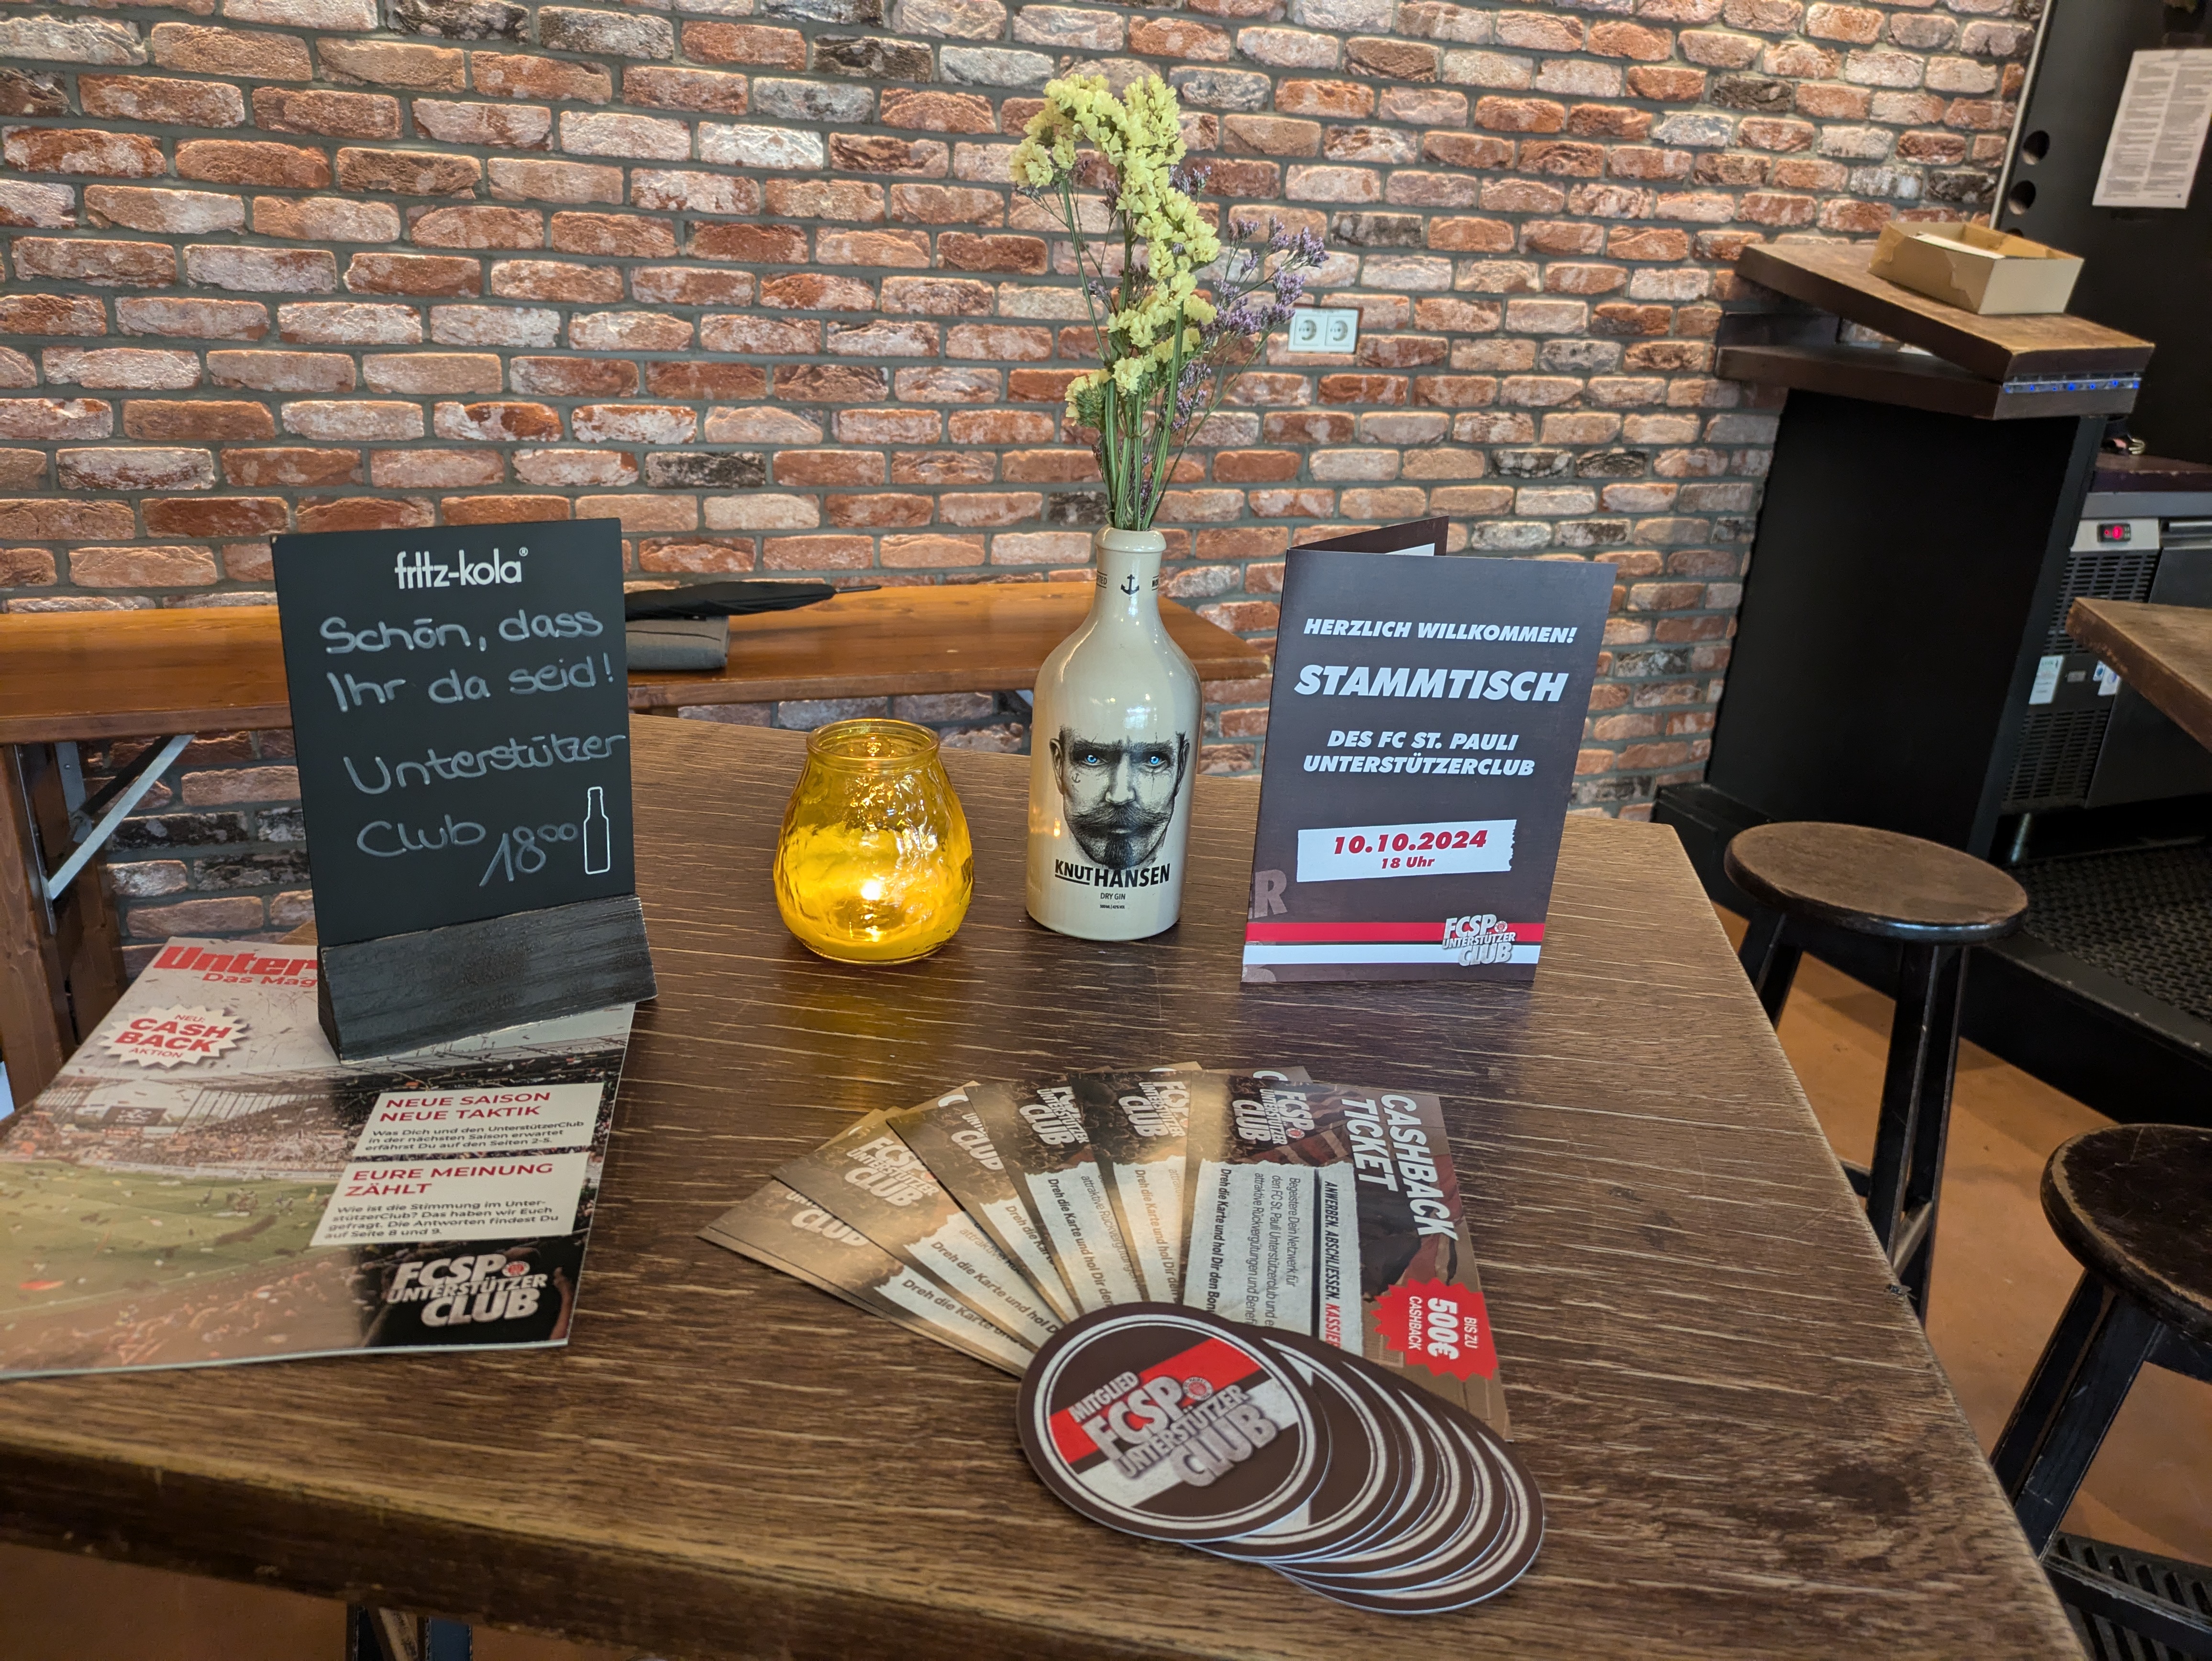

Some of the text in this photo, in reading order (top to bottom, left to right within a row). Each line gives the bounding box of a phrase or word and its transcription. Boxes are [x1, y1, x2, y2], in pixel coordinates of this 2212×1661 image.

[499, 609, 604, 642] dass
[1303, 618, 1577, 643] HERZLICH WILLKOMMEN!
[327, 653, 614, 712] Ihr da seid!
[1294, 664, 1570, 702] STAMMTISCH
[1327, 731, 1518, 751] DES FC ST. PAULI
[343, 734, 626, 795] Unterstützer
[1303, 752, 1536, 776] UNTERSTÜTZERCLUB
[357, 814, 486, 858] Club
[1334, 829, 1488, 855] 10.10.2024
[1382, 855, 1435, 870] 18 Uhr
[1443, 914, 1497, 939] FCSP
[1442, 932, 1516, 949] UNTERSTÜTZER
[1459, 942, 1512, 966] CLUB
[202, 973, 253, 984] Das
[130, 1018, 232, 1039] CASH
[115, 1031, 220, 1052] BACK
[130, 1047, 184, 1059] AKTION
[386, 1092, 551, 1108] NEUE SAISON
[1139, 1082, 1186, 1138] UNTERSTÜTZER
[1270, 1090, 1315, 1131] FCSP
[380, 1106, 542, 1122] NEUE TAKTIK
[488, 1120, 584, 1132] UnterstützerClub
[1019, 1104, 1075, 1145] CLUB
[1037, 1088, 1090, 1144] UNTERSTÜTZER
[1118, 1096, 1169, 1137] CLUB
[1232, 1099, 1272, 1141] CLUB
[1260, 1088, 1288, 1145] UNTERSTÜTZER
[365, 1142, 415, 1152] erfährst
[489, 1138, 529, 1146] Seiten
[407, 1133, 466, 1143] nächsten
[468, 1131, 509, 1141] Saison
[511, 1129, 564, 1139] erwartet
[1341, 1098, 1399, 1192] TICKET
[353, 1168, 423, 1181] EURE
[431, 1163, 553, 1177] MEINUNG
[846, 1148, 940, 1196] UNTERSTÜTZER
[1135, 1169, 1149, 1189] Dreh
[1381, 1094, 1459, 1241] CASHBACK
[344, 1182, 432, 1196] ZÄHLT
[844, 1167, 923, 1207] CLUB
[1048, 1178, 1065, 1198] Dreh
[1081, 1175, 1104, 1210] attraktive
[1253, 1172, 1264, 1206] attraktive
[1272, 1175, 1281, 1189] den
[410, 1201, 482, 1211] Stimmung
[1057, 1197, 1070, 1212] die
[1141, 1189, 1152, 1202] die
[1271, 1201, 1283, 1213] St.
[1272, 1190, 1283, 1201] FC
[1325, 1181, 1338, 1228] ANWERBEN.
[328, 1221, 384, 1232] gefragt.
[412, 1218, 487, 1227] Antworten
[489, 1216, 536, 1225] findest
[333, 1211, 418, 1222] stützerClub?
[450, 1208, 492, 1217] haben
[520, 1206, 553, 1215] Euch
[1005, 1206, 1037, 1240] Dreh die
[1064, 1211, 1082, 1238] Karte
[1146, 1203, 1160, 1226] Karte
[1269, 1212, 1282, 1231] Pauli
[324, 1230, 347, 1240] auf
[1153, 1226, 1165, 1245] und
[1206, 1168, 1232, 1313] Dreh die Karte und hol Dir den Bon
[1245, 1206, 1264, 1274] Rückvergütungen
[1286, 1177, 1301, 1287] Begeistere Dein Netzwerk für
[1076, 1236, 1094, 1256] und
[1158, 1245, 1172, 1260] hol
[391, 1253, 508, 1290] FCSP
[1084, 1254, 1096, 1270] hol
[1162, 1262, 1176, 1275] Dir
[1266, 1231, 1281, 1300] Unterstützerclub
[1325, 1229, 1340, 1300] ABSCHLIESSEN.
[387, 1273, 549, 1305] UNTERSTÜTZER
[931, 1241, 1050, 1327] Dreh die Karte und hol
[1091, 1267, 1106, 1287] Dir
[1246, 1275, 1258, 1292] und
[902, 1279, 955, 1310] Dreh die
[420, 1287, 541, 1328] CLUB
[1265, 1300, 1278, 1318] und
[1408, 1296, 1423, 1351] CASHBACK
[1427, 1297, 1459, 1360] 500€
[1464, 1317, 1478, 1349] BIS ZU
[1068, 1371, 1140, 1423] MITGLIED
[1081, 1375, 1183, 1461] FCSP
[1115, 1384, 1251, 1478] UNTERSTÜTZER
[1171, 1403, 1278, 1487] CLUB
